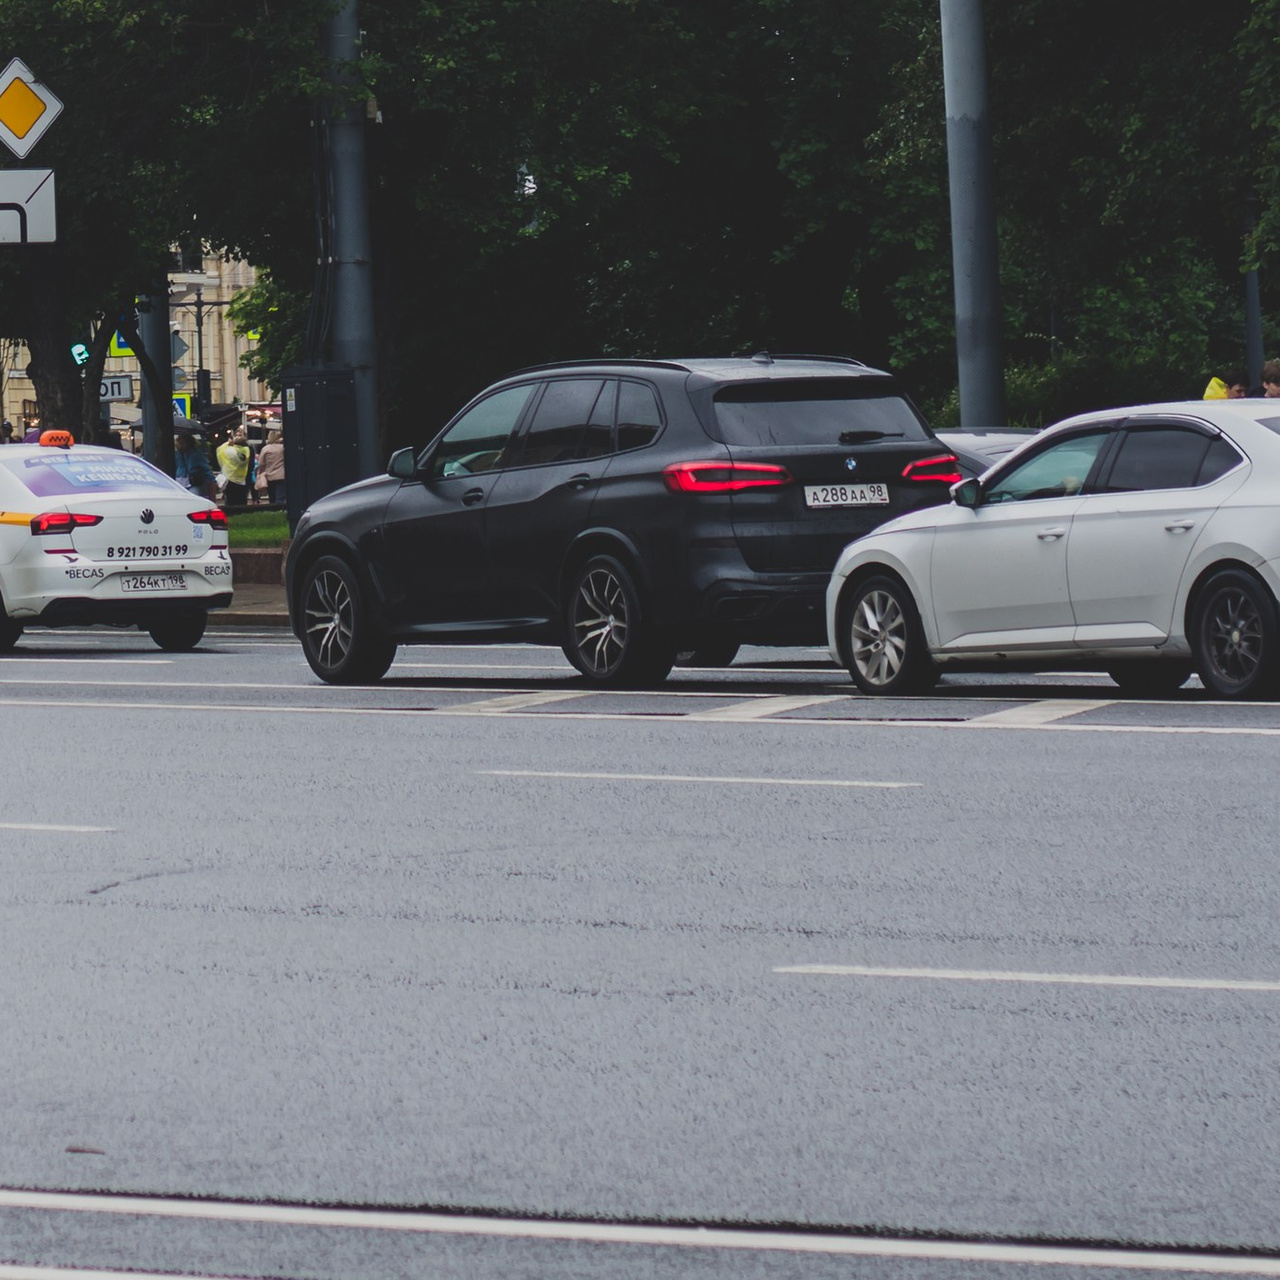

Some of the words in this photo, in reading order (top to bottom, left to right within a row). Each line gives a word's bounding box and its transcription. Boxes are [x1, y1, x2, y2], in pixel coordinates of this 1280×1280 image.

[76, 473, 159, 484] КЕШБЭКА
[106, 546, 115, 558] 8
[117, 546, 136, 558] 921
[140, 545, 159, 557] 790
[161, 545, 172, 557] 31
[175, 544, 188, 556] 99
[69, 568, 104, 579] BECAS
